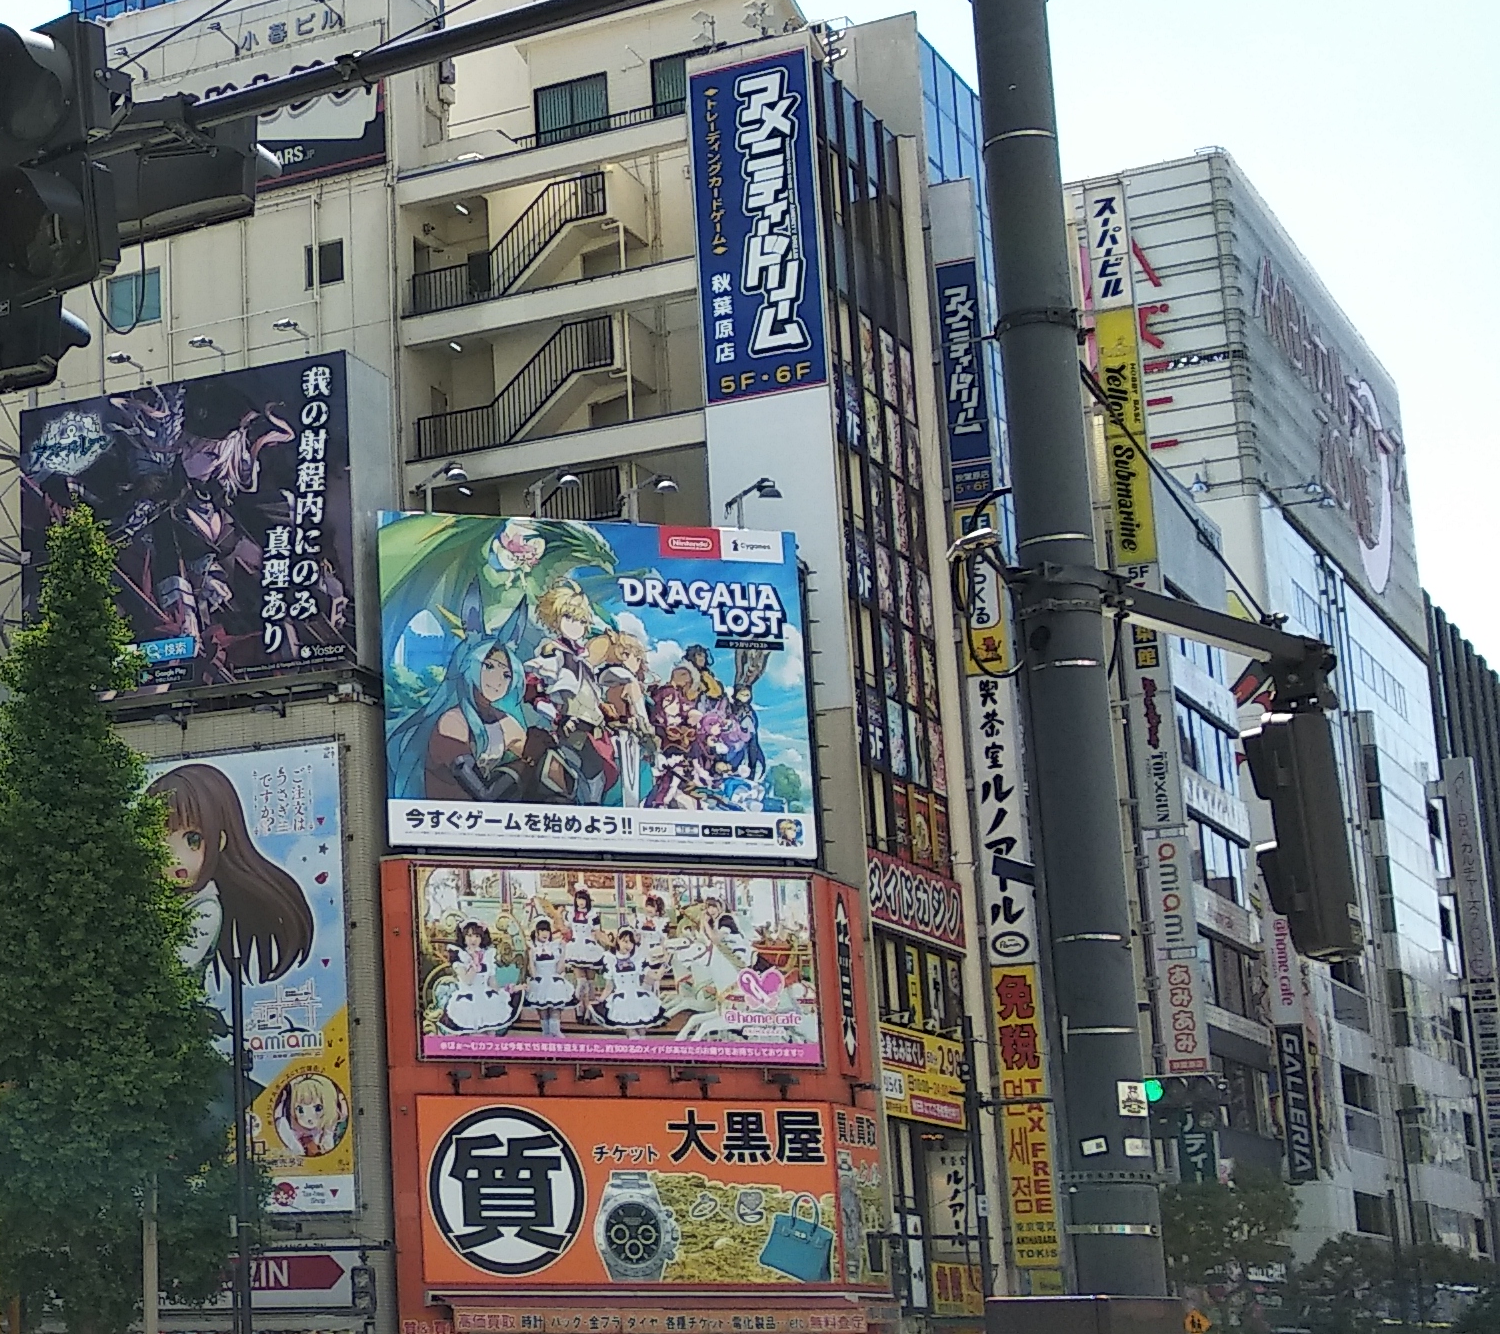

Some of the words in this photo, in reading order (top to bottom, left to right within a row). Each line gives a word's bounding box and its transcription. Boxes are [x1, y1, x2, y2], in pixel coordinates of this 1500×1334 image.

[241, 10, 345, 51] 小暮ビル
[704, 99, 727, 247] トレーディングカードゲーム
[1094, 197, 1123, 297] スーパービル
[711, 274, 735, 362] 秋葉原店
[290, 366, 332, 619] 我の射程内にのみ
[1113, 444, 1137, 551] Submarine
[673, 539, 709, 548] Nintendo
[1128, 566, 1149, 580] 5F
[261, 527, 293, 653] 真理あり
[619, 578, 781, 612] DRAGALIA
[709, 607, 782, 635] LOST
[311, 643, 346, 658] Yostar
[291, 767, 306, 831] ご注文は
[979, 681, 1026, 925] 喫茶室ルノアール
[868, 857, 961, 940] メイドカジノ
[1158, 842, 1184, 945] amiami
[725, 1011, 773, 1025] @home
[775, 1011, 802, 1025] cafe
[1168, 964, 1197, 1053] あみあみ
[1278, 970, 1295, 1007] cafe
[251, 1033, 323, 1049] amiami
[996, 974, 1040, 1070] 免税
[938, 1045, 962, 1079] 2,98
[668, 1108, 826, 1164] 大黒屋
[1278, 1034, 1313, 1174] GALLERIA
[594, 1145, 658, 1163] チケット
[1032, 1143, 1054, 1214] FREE
[447, 1134, 571, 1254] 質
[1017, 1249, 1058, 1258] TOKIS
[457, 1313, 516, 1330] 高価買取
[521, 1315, 544, 1330] 時計
[809, 1315, 866, 1331] 無料査定
